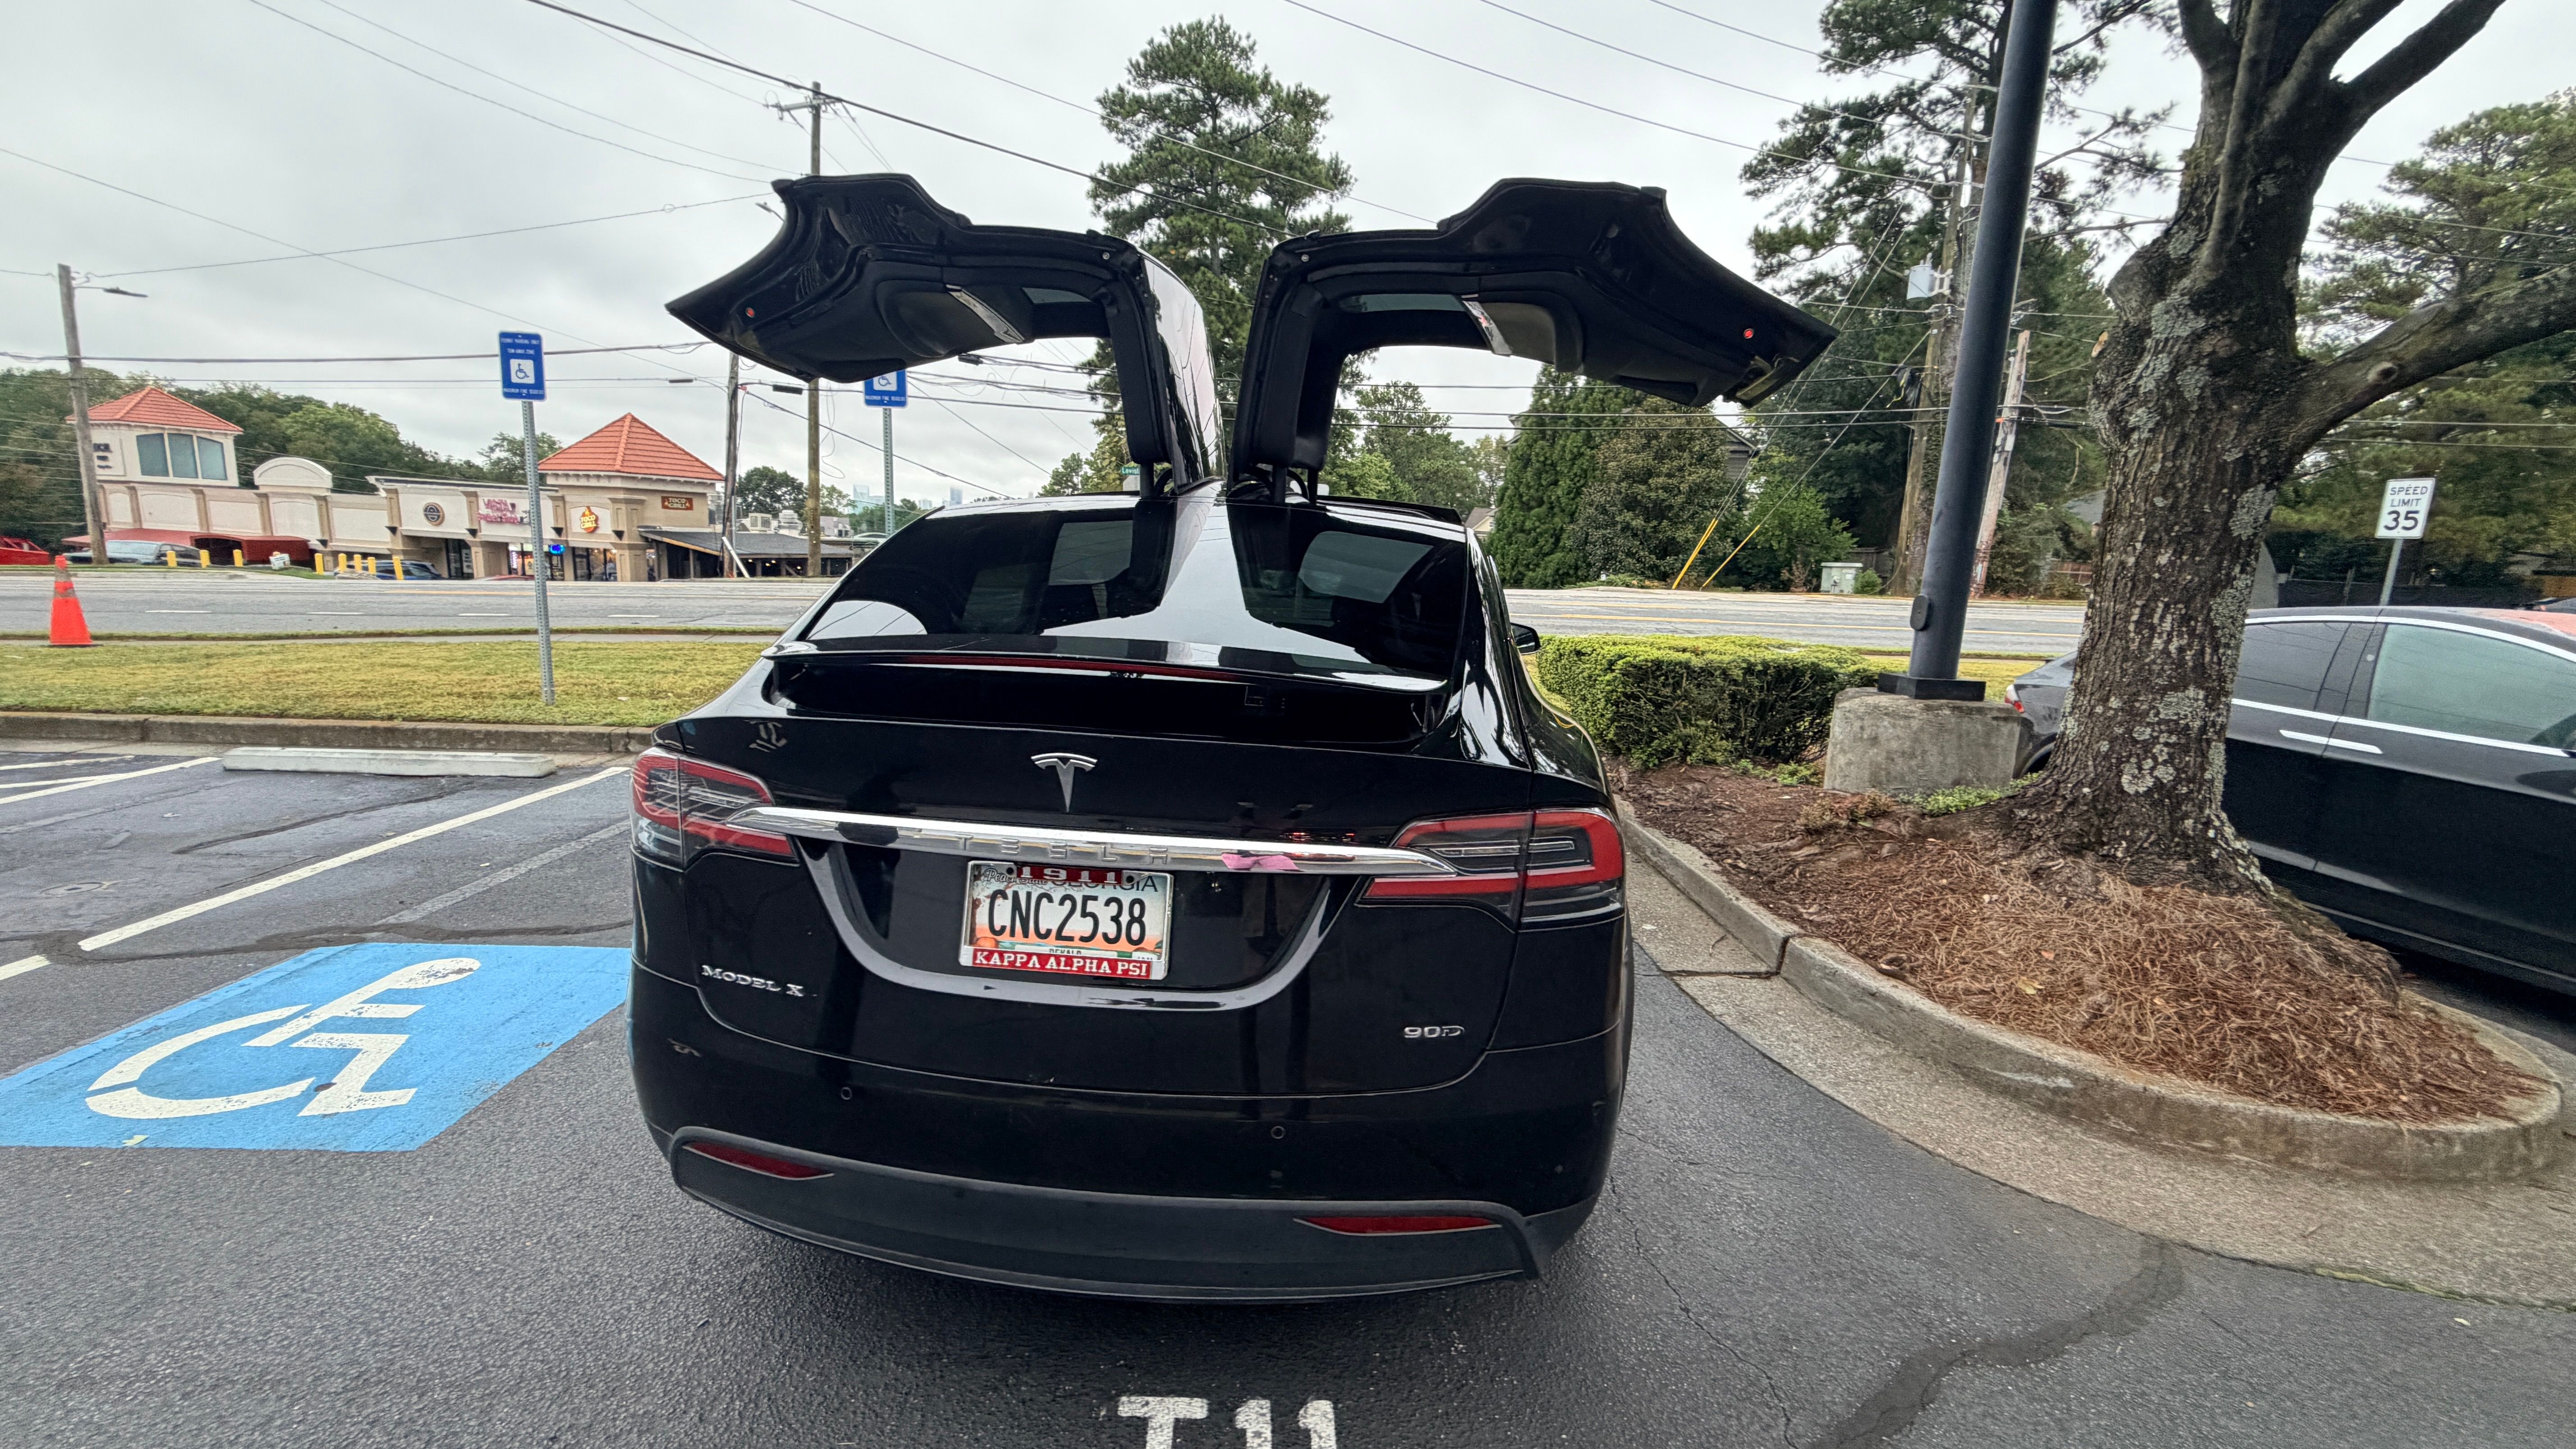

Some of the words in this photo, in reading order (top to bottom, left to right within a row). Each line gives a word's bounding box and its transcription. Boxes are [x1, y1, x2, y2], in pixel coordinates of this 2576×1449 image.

[2390, 486, 2428, 495] SPEED
[2390, 498, 2422, 507] LIMIT
[580, 515, 595, 523] TOCO
[2383, 510, 2420, 531] 35
[956, 834, 1168, 865] TESLA
[1021, 866, 1118, 884] 1911
[988, 889, 1146, 946] CNC2538
[975, 952, 1041, 968] KAPPA
[1045, 957, 1112, 973] ALPHA
[1117, 961, 1147, 976] PSI
[702, 965, 781, 992] MODEL
[786, 984, 804, 997] X
[1404, 1026, 1465, 1038] 90D
